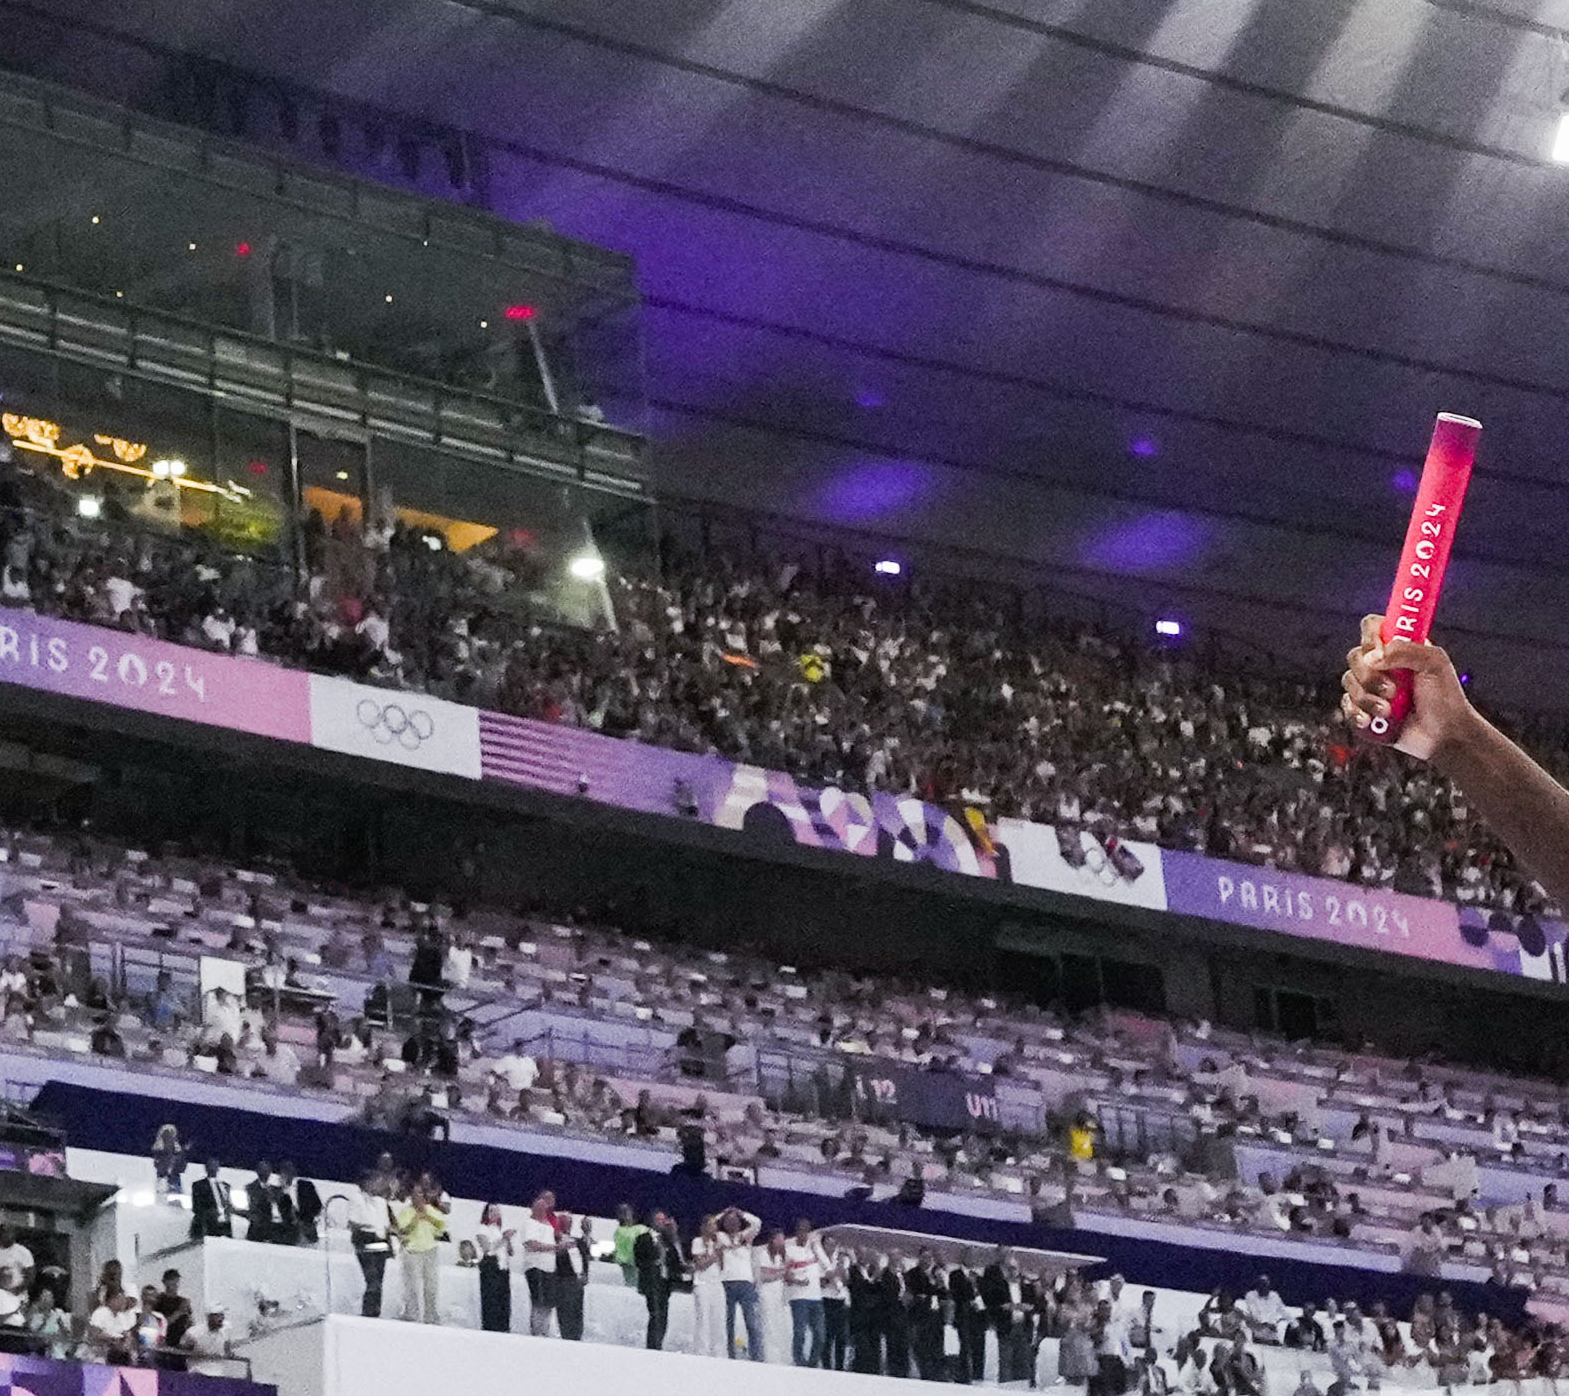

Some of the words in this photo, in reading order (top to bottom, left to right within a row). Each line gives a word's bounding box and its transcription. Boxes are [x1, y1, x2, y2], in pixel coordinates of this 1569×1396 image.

[1392, 586, 1425, 643] RIS
[1410, 503, 1447, 579] 2024
[88, 645, 205, 703] 2024
[1217, 875, 1314, 921] PARIS
[1325, 895, 1411, 938] 2024
